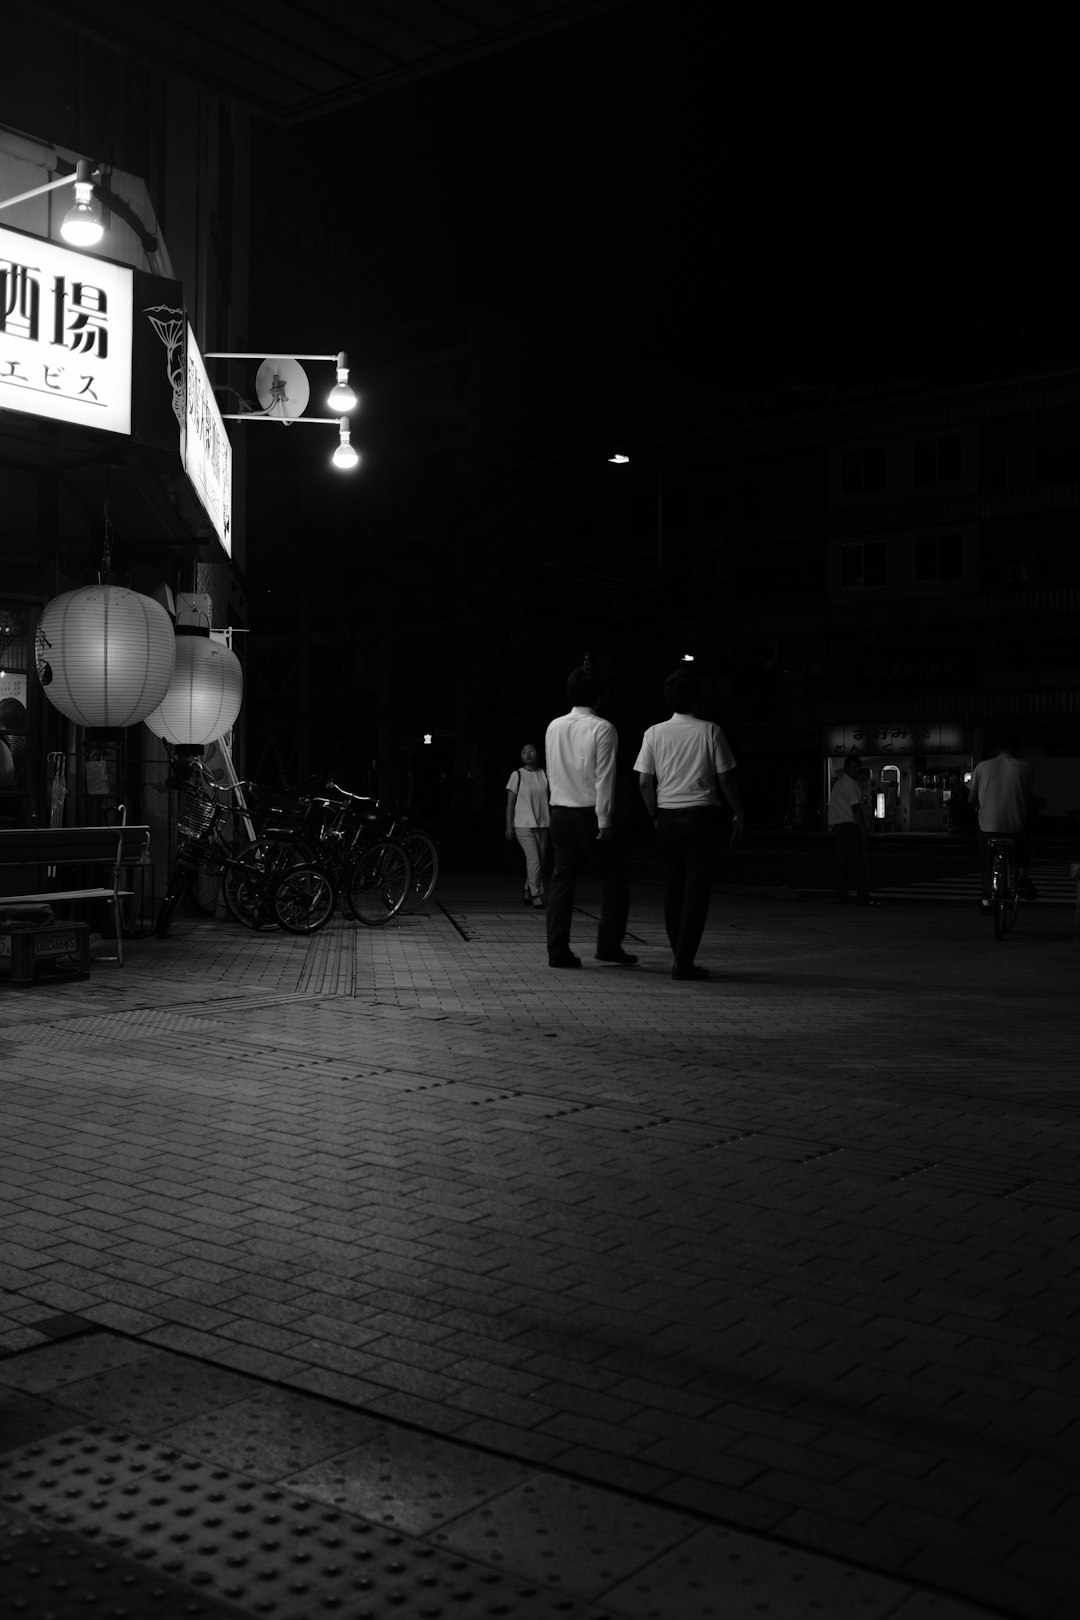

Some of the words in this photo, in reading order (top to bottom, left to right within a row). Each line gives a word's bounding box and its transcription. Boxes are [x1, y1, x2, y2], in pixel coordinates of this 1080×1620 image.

[0, 258, 108, 359] 酒場
[0, 360, 98, 401] エビス
